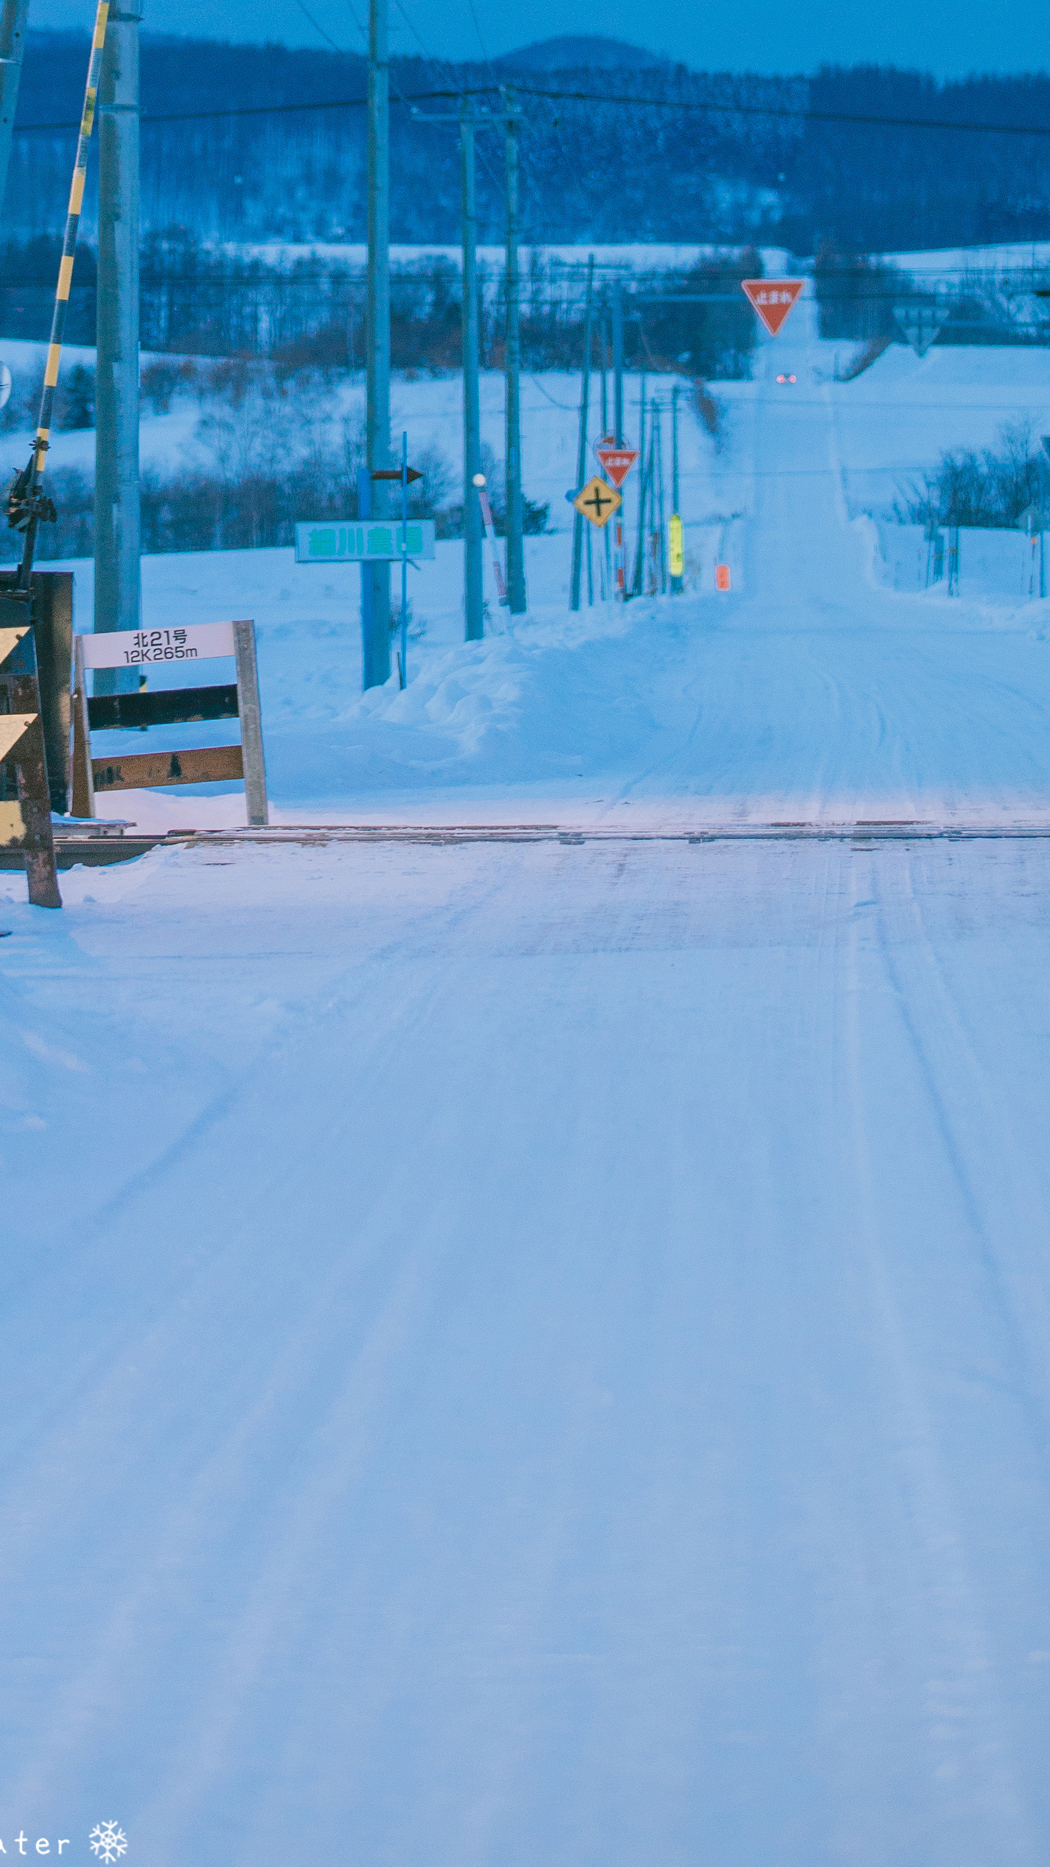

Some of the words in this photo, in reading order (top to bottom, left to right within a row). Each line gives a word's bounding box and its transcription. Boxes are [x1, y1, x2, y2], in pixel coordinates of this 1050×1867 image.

[756, 290, 793, 305] 止まれ
[133, 629, 188, 648] 北21号
[124, 646, 198, 664] 12K265m
